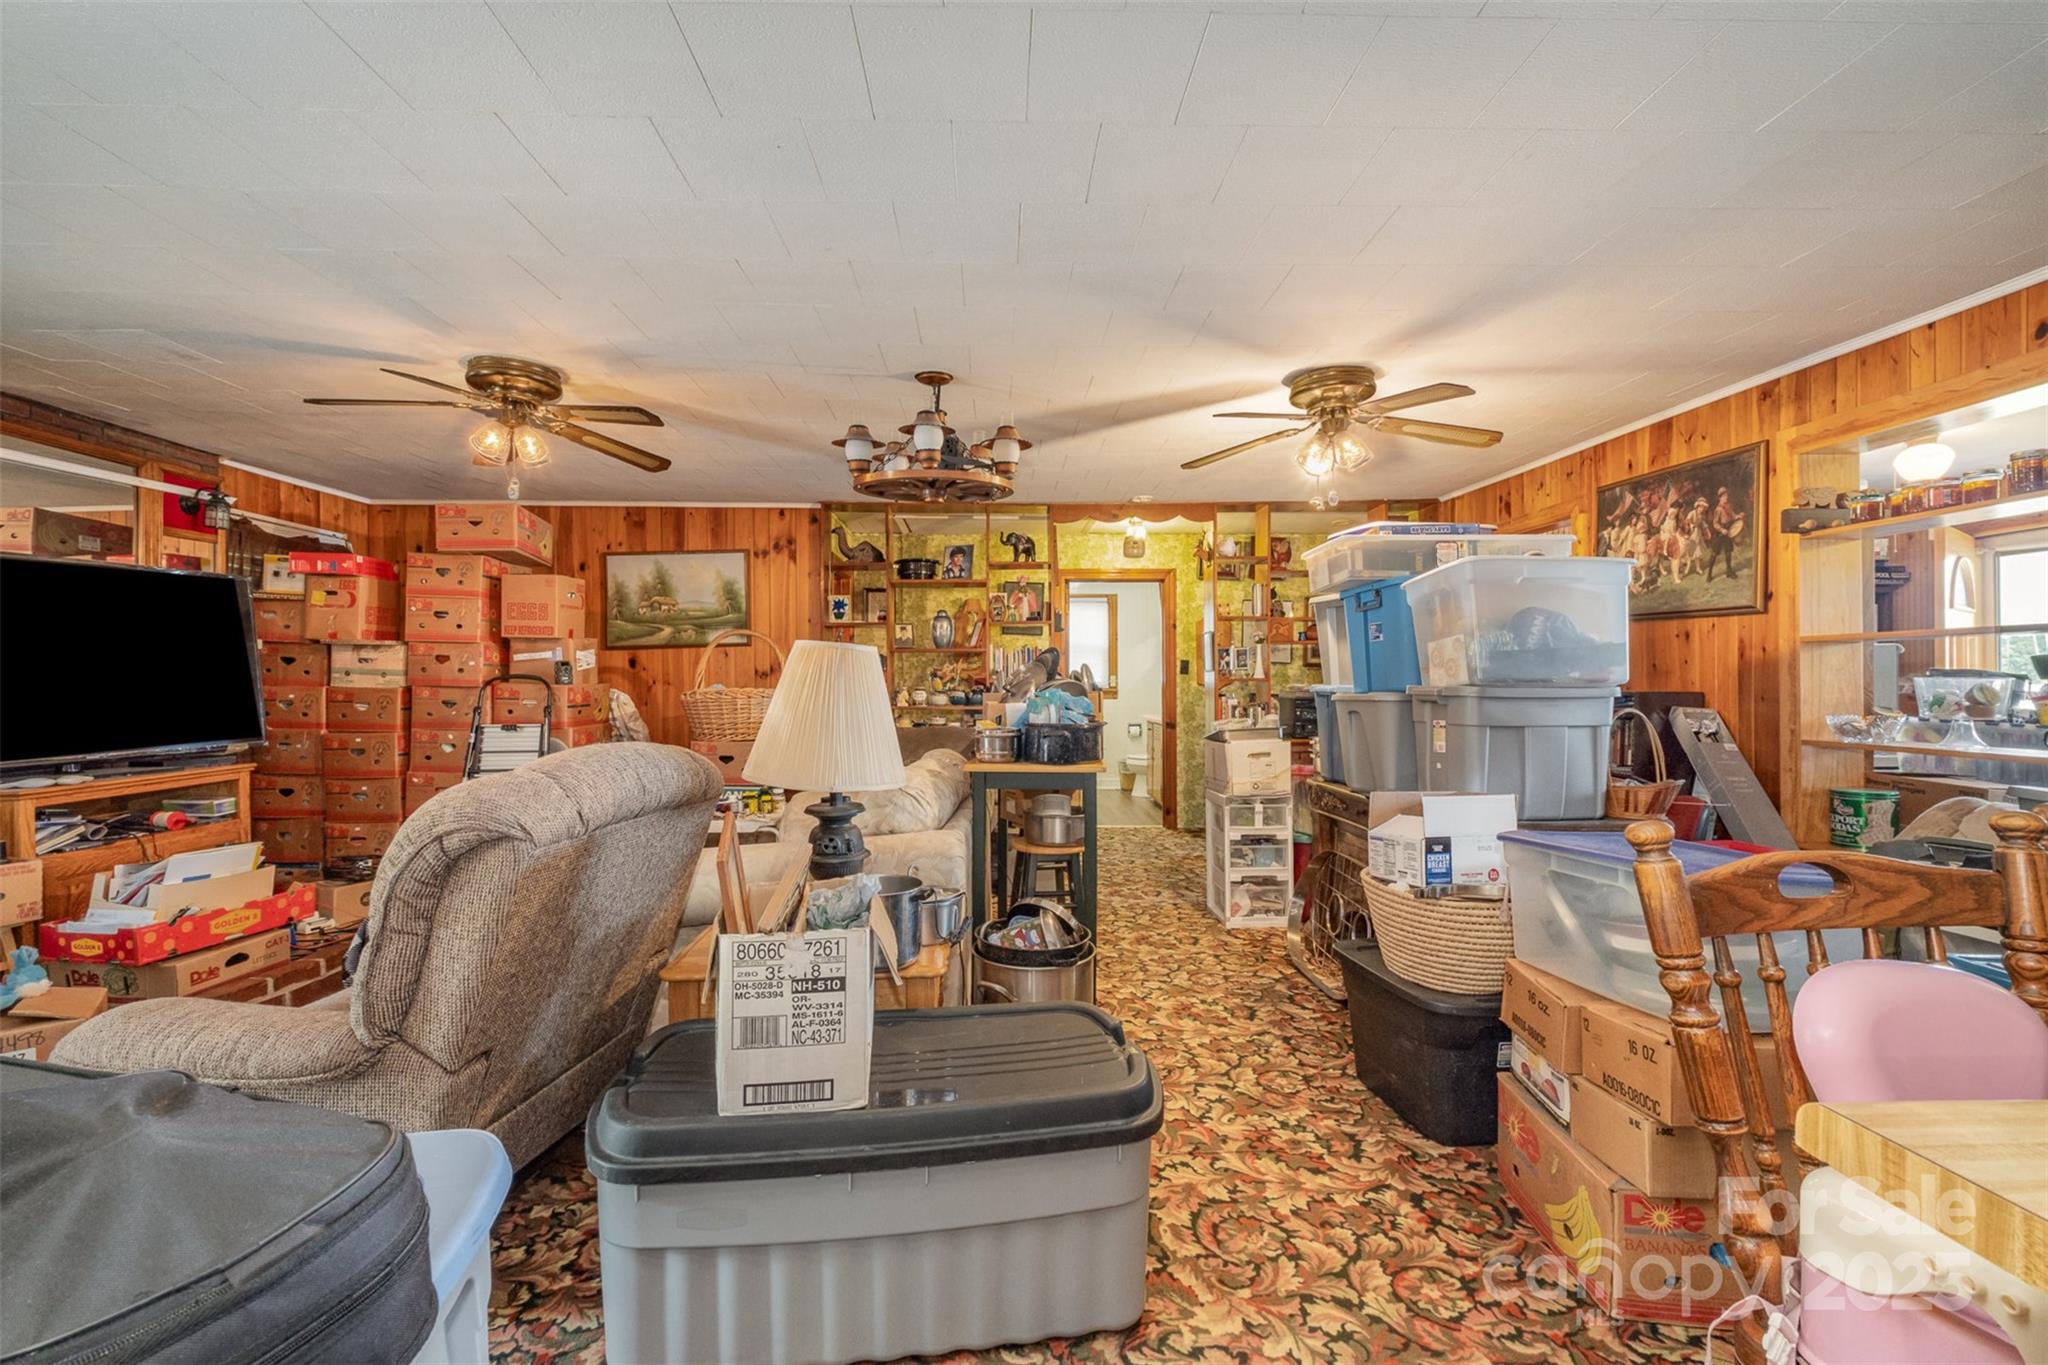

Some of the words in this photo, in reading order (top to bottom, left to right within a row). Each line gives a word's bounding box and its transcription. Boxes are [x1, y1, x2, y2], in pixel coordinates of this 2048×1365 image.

[438, 505, 465, 517] Dole
[408, 555, 433, 568] Dole
[483, 557, 509, 577] Dole
[506, 602, 549, 621] EGGS
[213, 915, 250, 930] GOLDEN
[804, 940, 840, 957] 7261
[71, 969, 100, 984] Dole
[190, 966, 220, 984] Dole
[734, 981, 784, 991] OH-5028-D
[791, 980, 841, 992] NH-510
[734, 991, 784, 1001] MC-35394
[1527, 989, 1538, 1006] 16
[791, 1010, 844, 1019] MS-1611-6
[792, 1002, 843, 1011] WV-3314
[791, 1019, 842, 1028] AL-F-0364
[1582, 1016, 1590, 1033] 12
[791, 1028, 842, 1045] NC-43-371
[1627, 1038, 1639, 1056] 16
[1623, 1194, 1706, 1234] Dole
[1624, 1237, 1709, 1256] BANANAS
